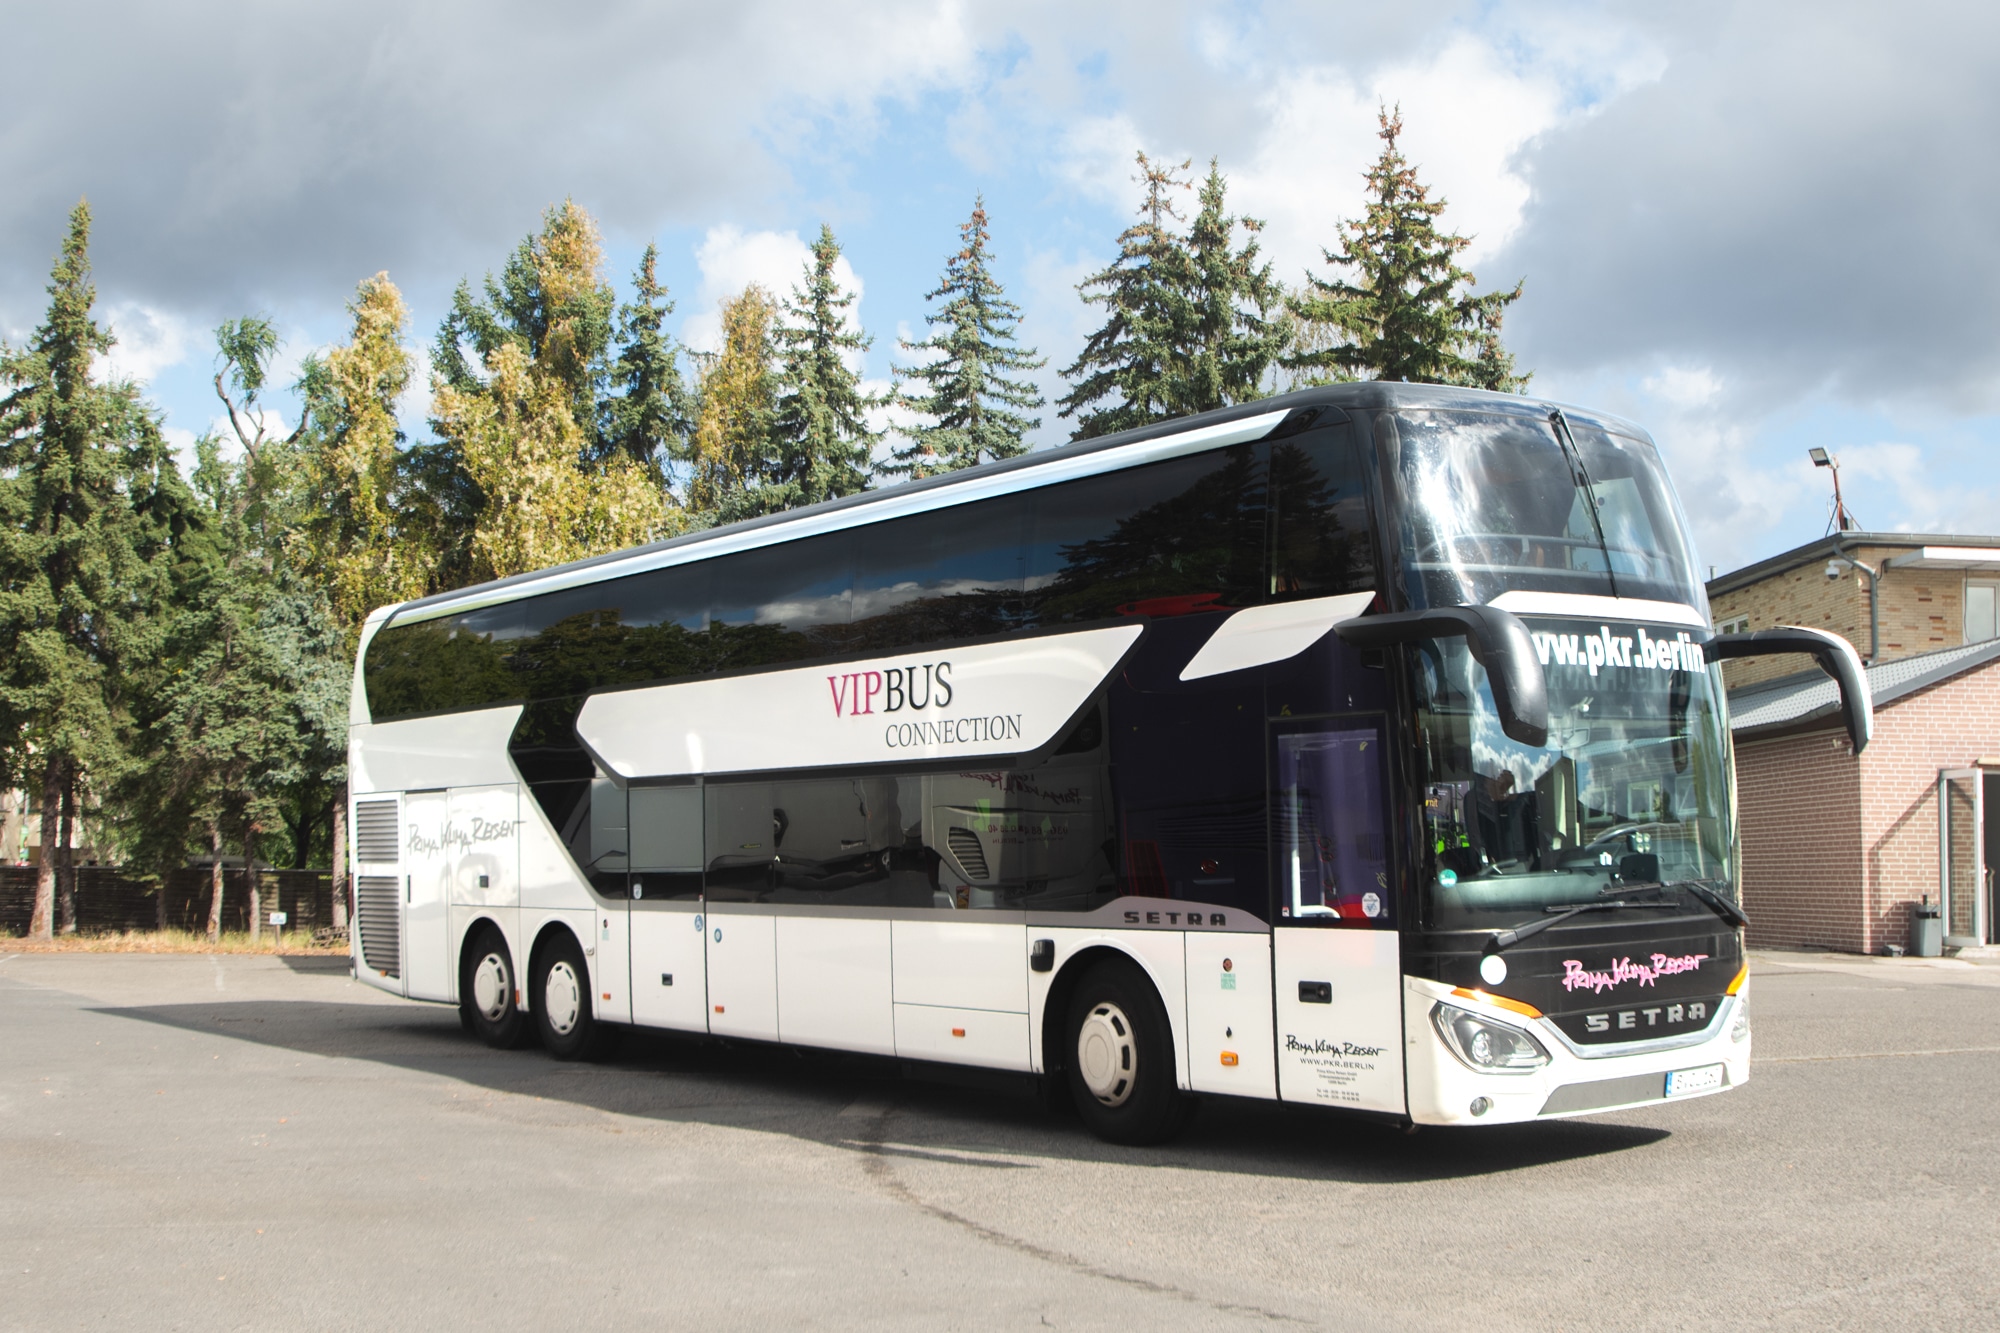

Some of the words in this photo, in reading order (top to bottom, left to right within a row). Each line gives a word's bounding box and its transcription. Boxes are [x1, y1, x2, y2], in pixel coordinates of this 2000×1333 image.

[827, 661, 953, 719] VIPBUS
[885, 714, 1022, 748] CONNECTION
[1123, 911, 1226, 926] SETRA
[1585, 1003, 1706, 1032] SETRA
[1300, 1058, 1374, 1070] WWW.PKR.BERLIN
